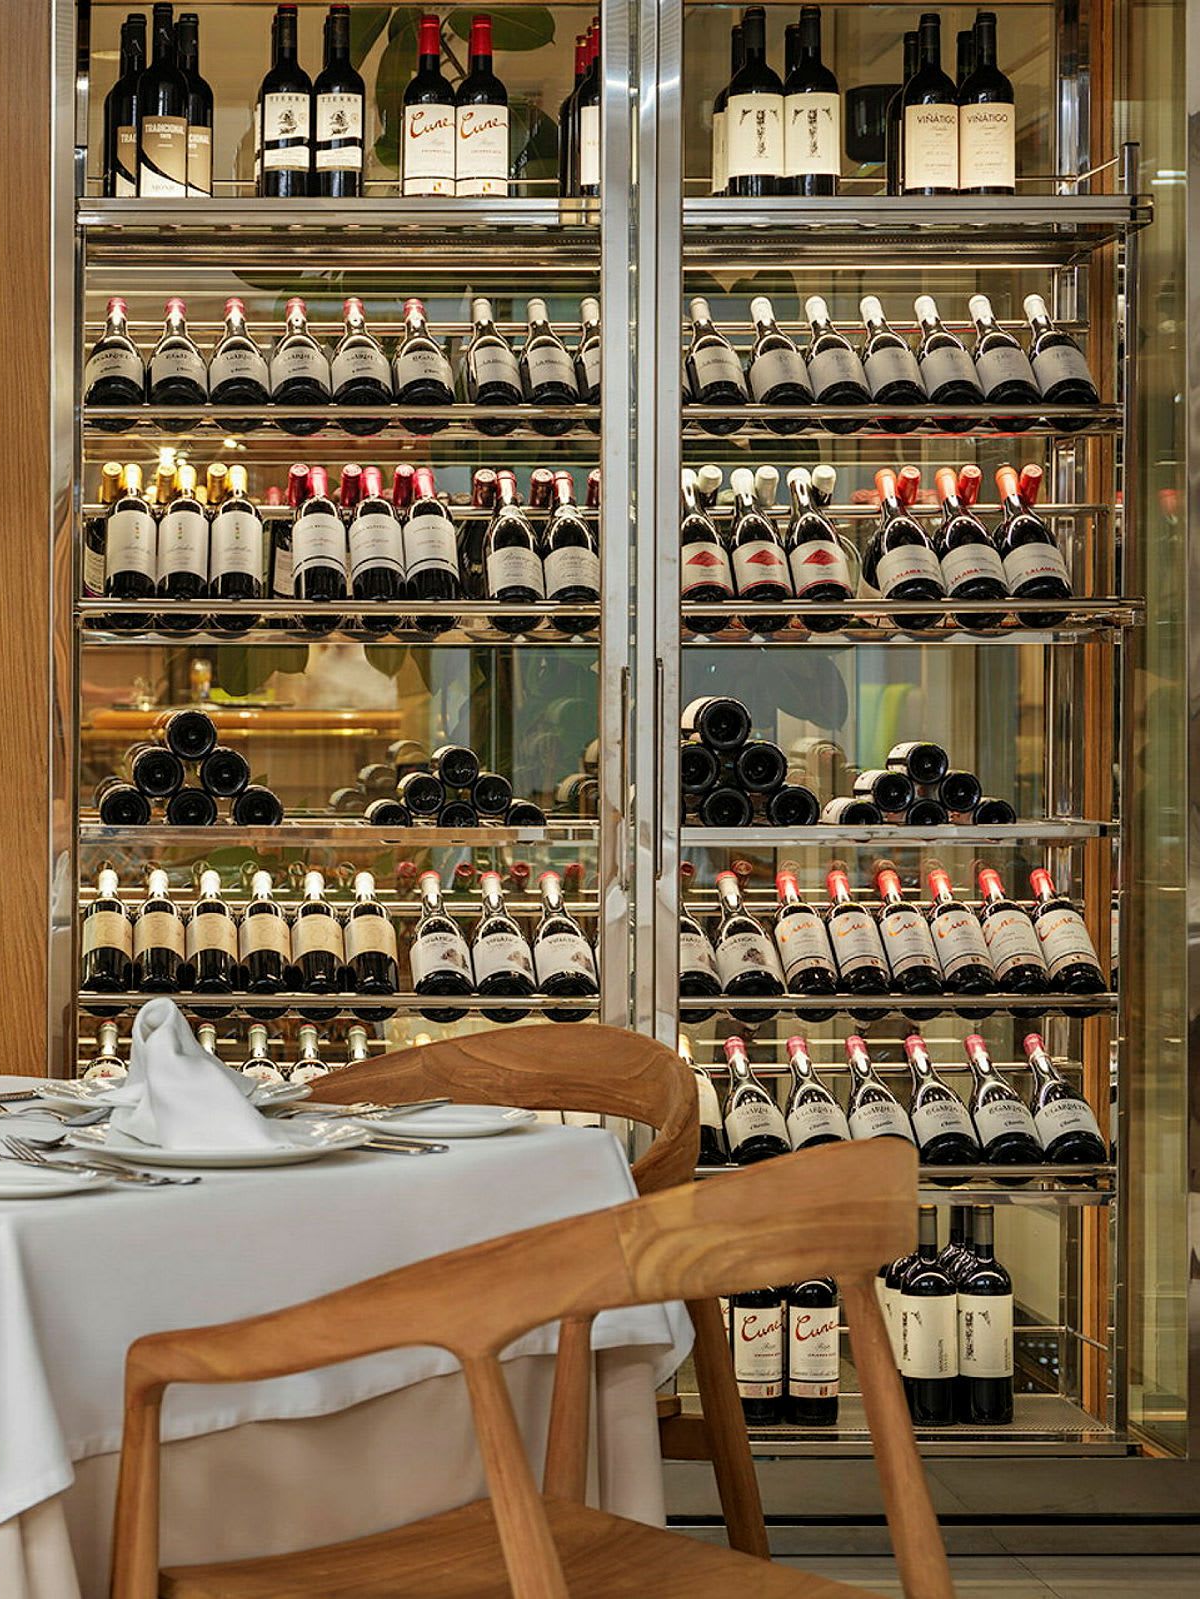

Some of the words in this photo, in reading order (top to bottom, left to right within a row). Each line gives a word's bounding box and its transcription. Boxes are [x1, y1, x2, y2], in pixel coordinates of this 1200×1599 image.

[269, 95, 306, 103] TIERRA
[145, 123, 185, 135] TRADICIONAL
[410, 111, 456, 139] Cune
[461, 111, 509, 139] Cune
[795, 1315, 840, 1341] Cune
